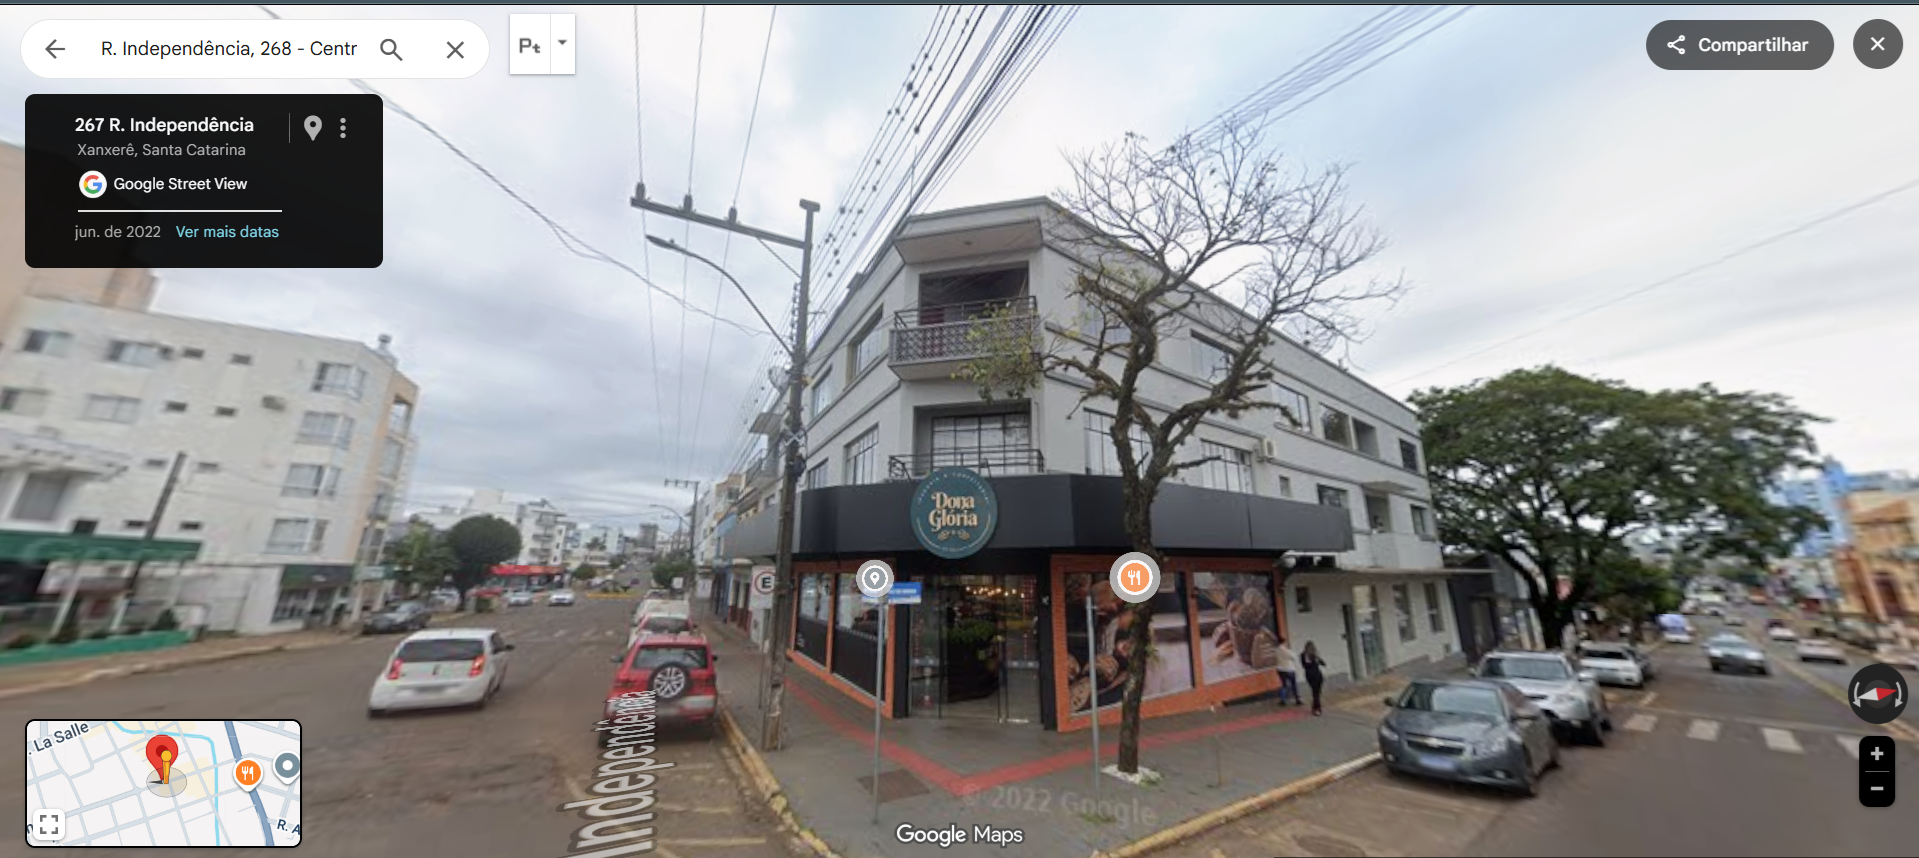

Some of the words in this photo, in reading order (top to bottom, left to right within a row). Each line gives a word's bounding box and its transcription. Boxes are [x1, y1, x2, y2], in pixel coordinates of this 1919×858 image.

[931, 491, 975, 510] Dona
[928, 509, 978, 533] Glória
[761, 577, 772, 589] E
